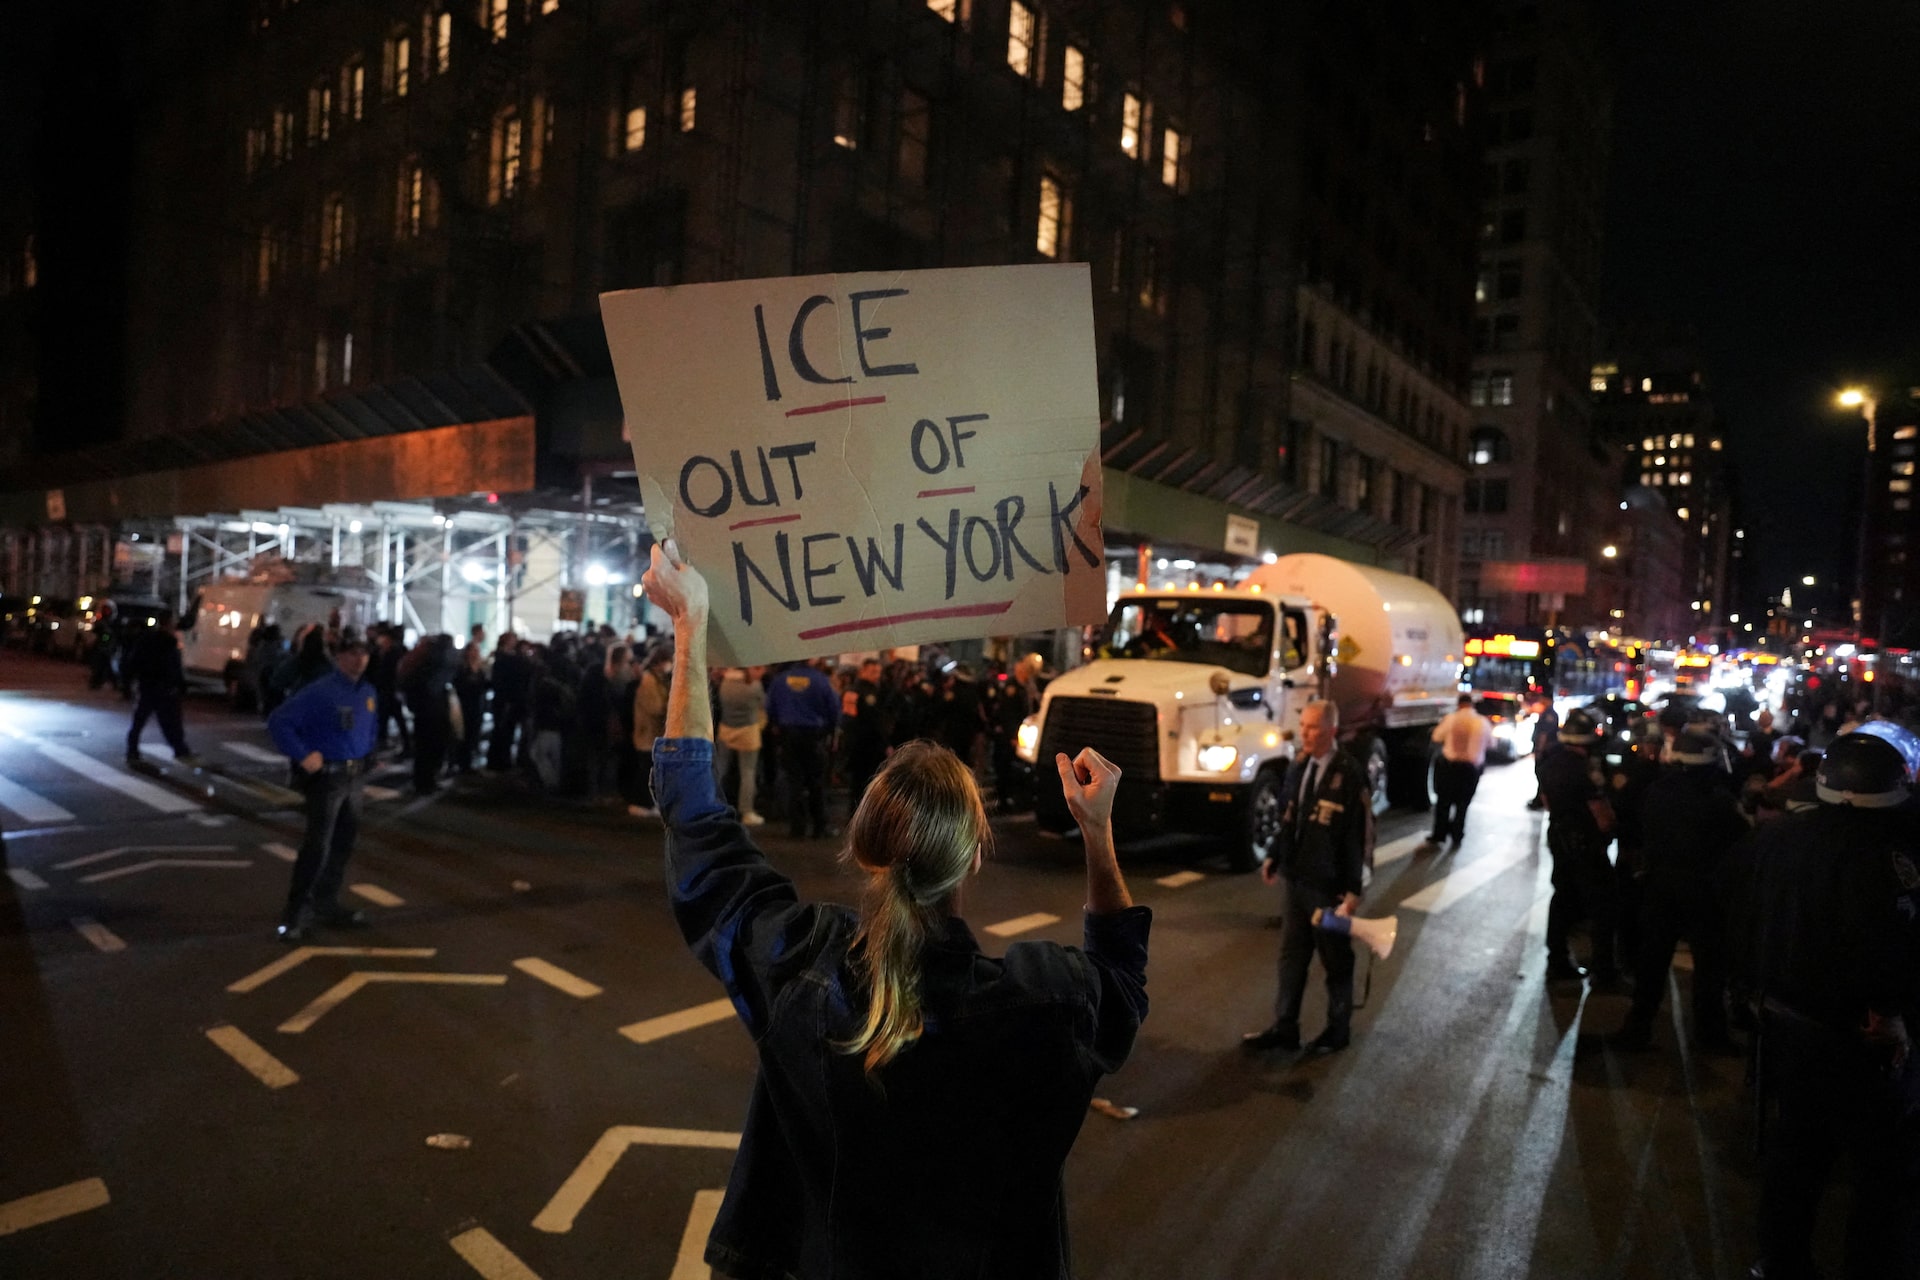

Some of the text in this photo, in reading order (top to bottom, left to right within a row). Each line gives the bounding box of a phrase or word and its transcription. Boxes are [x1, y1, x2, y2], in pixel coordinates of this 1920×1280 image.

[755, 288, 919, 401] ICE
[679, 413, 989, 518] OUT OF
[731, 481, 1100, 626] NEW YORK
